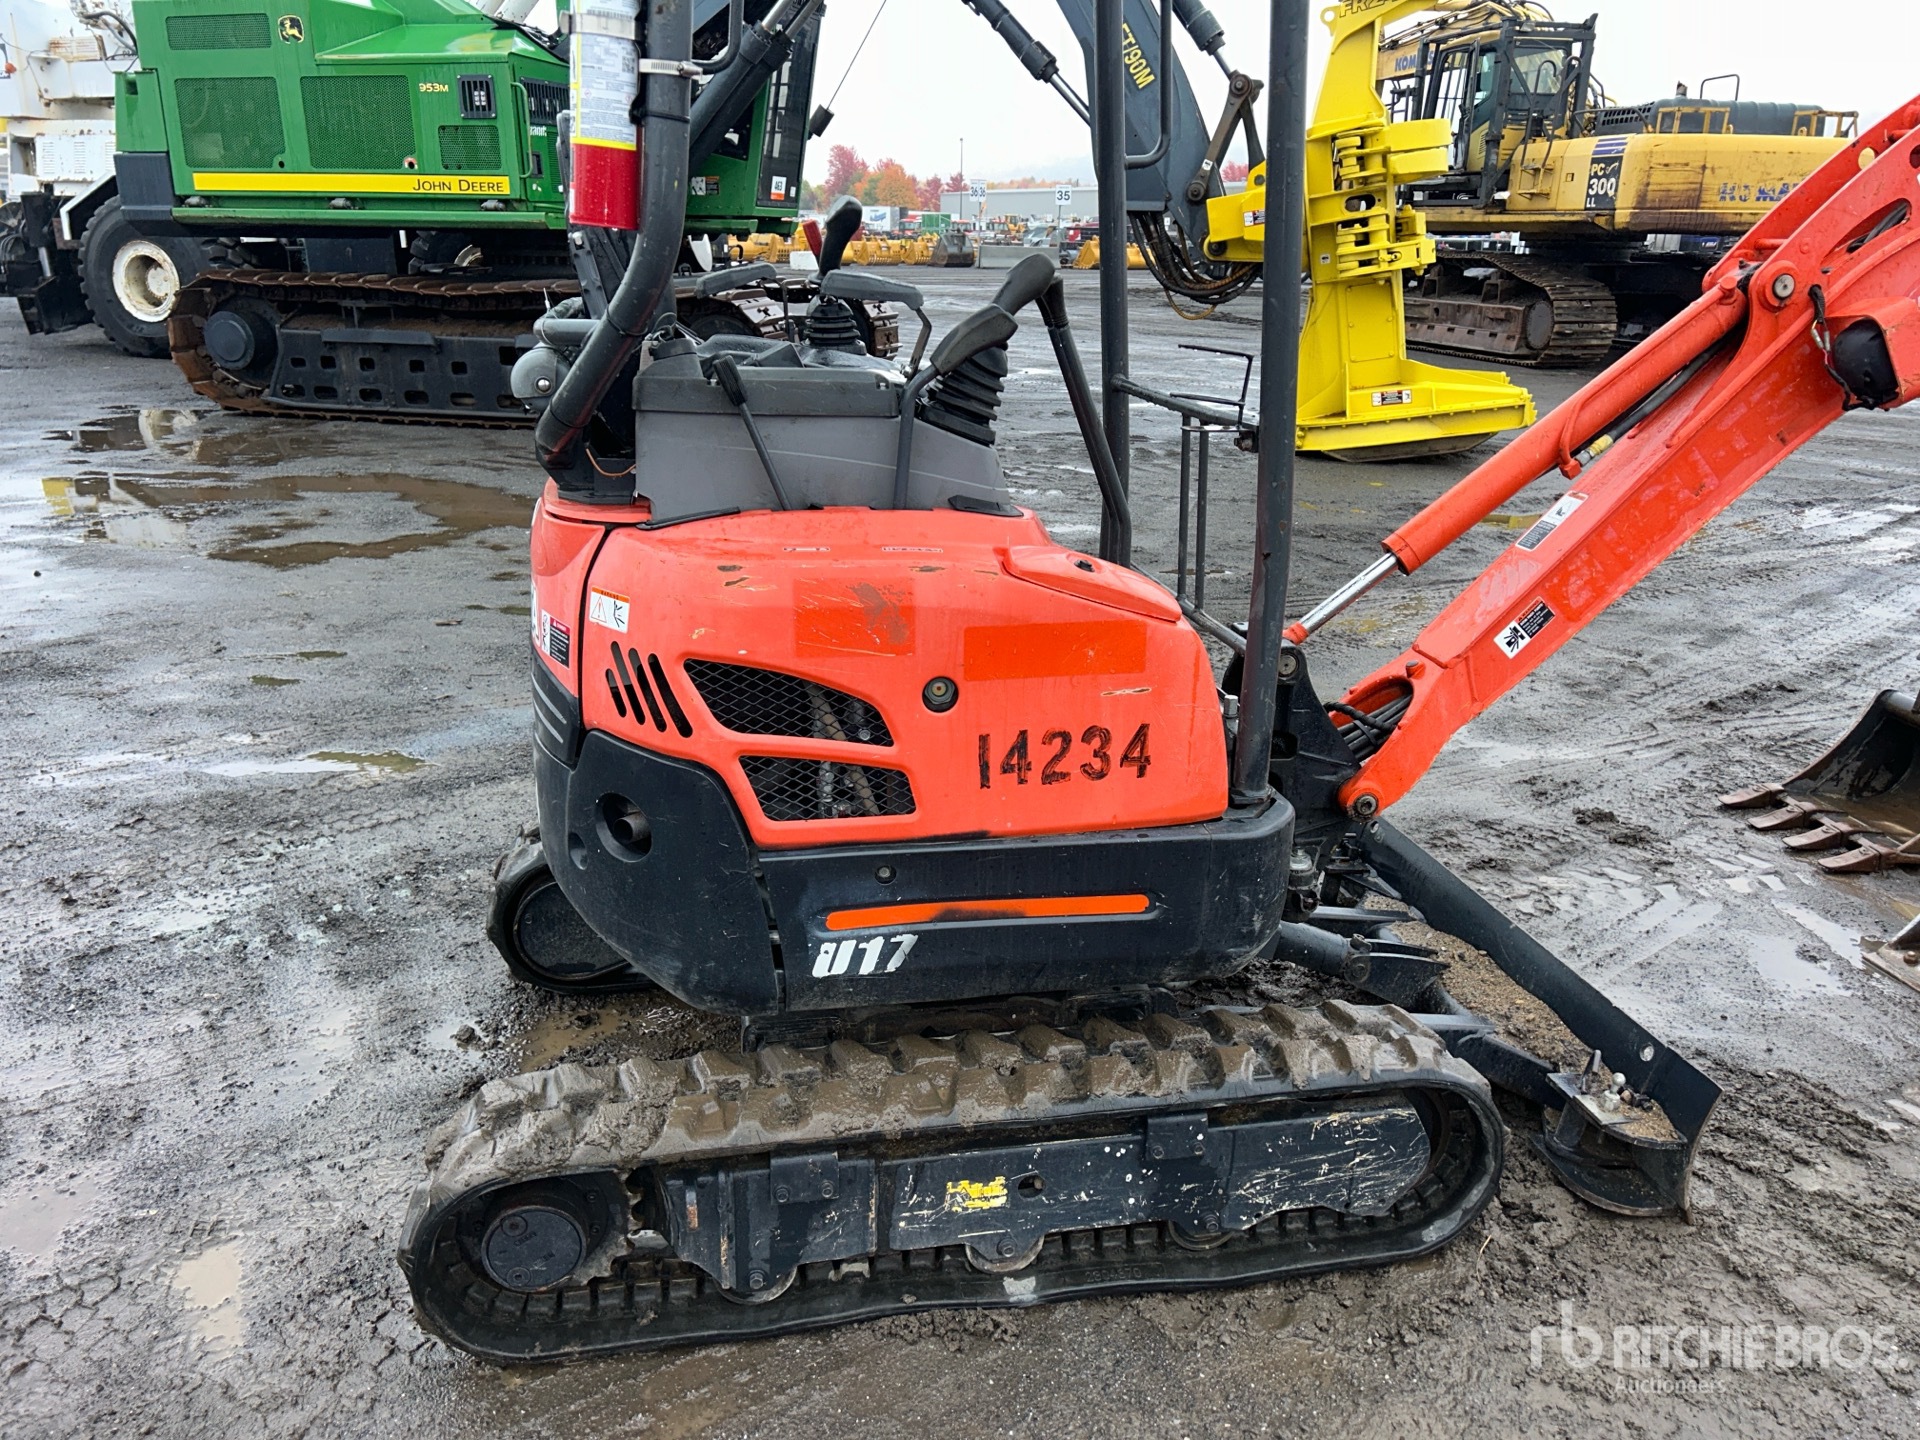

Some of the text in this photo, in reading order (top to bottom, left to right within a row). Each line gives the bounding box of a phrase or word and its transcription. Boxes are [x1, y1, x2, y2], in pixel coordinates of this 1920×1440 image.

[419, 83, 449, 93] 953M
[1591, 163, 1605, 176] PC
[412, 179, 505, 192] JOHN DEERE
[970, 186, 978, 197] 36
[979, 186, 986, 197] 36
[1056, 190, 1071, 201] 35
[1586, 197, 1596, 208] LL
[978, 723, 1151, 790] 14234
[811, 933, 919, 978] U17
